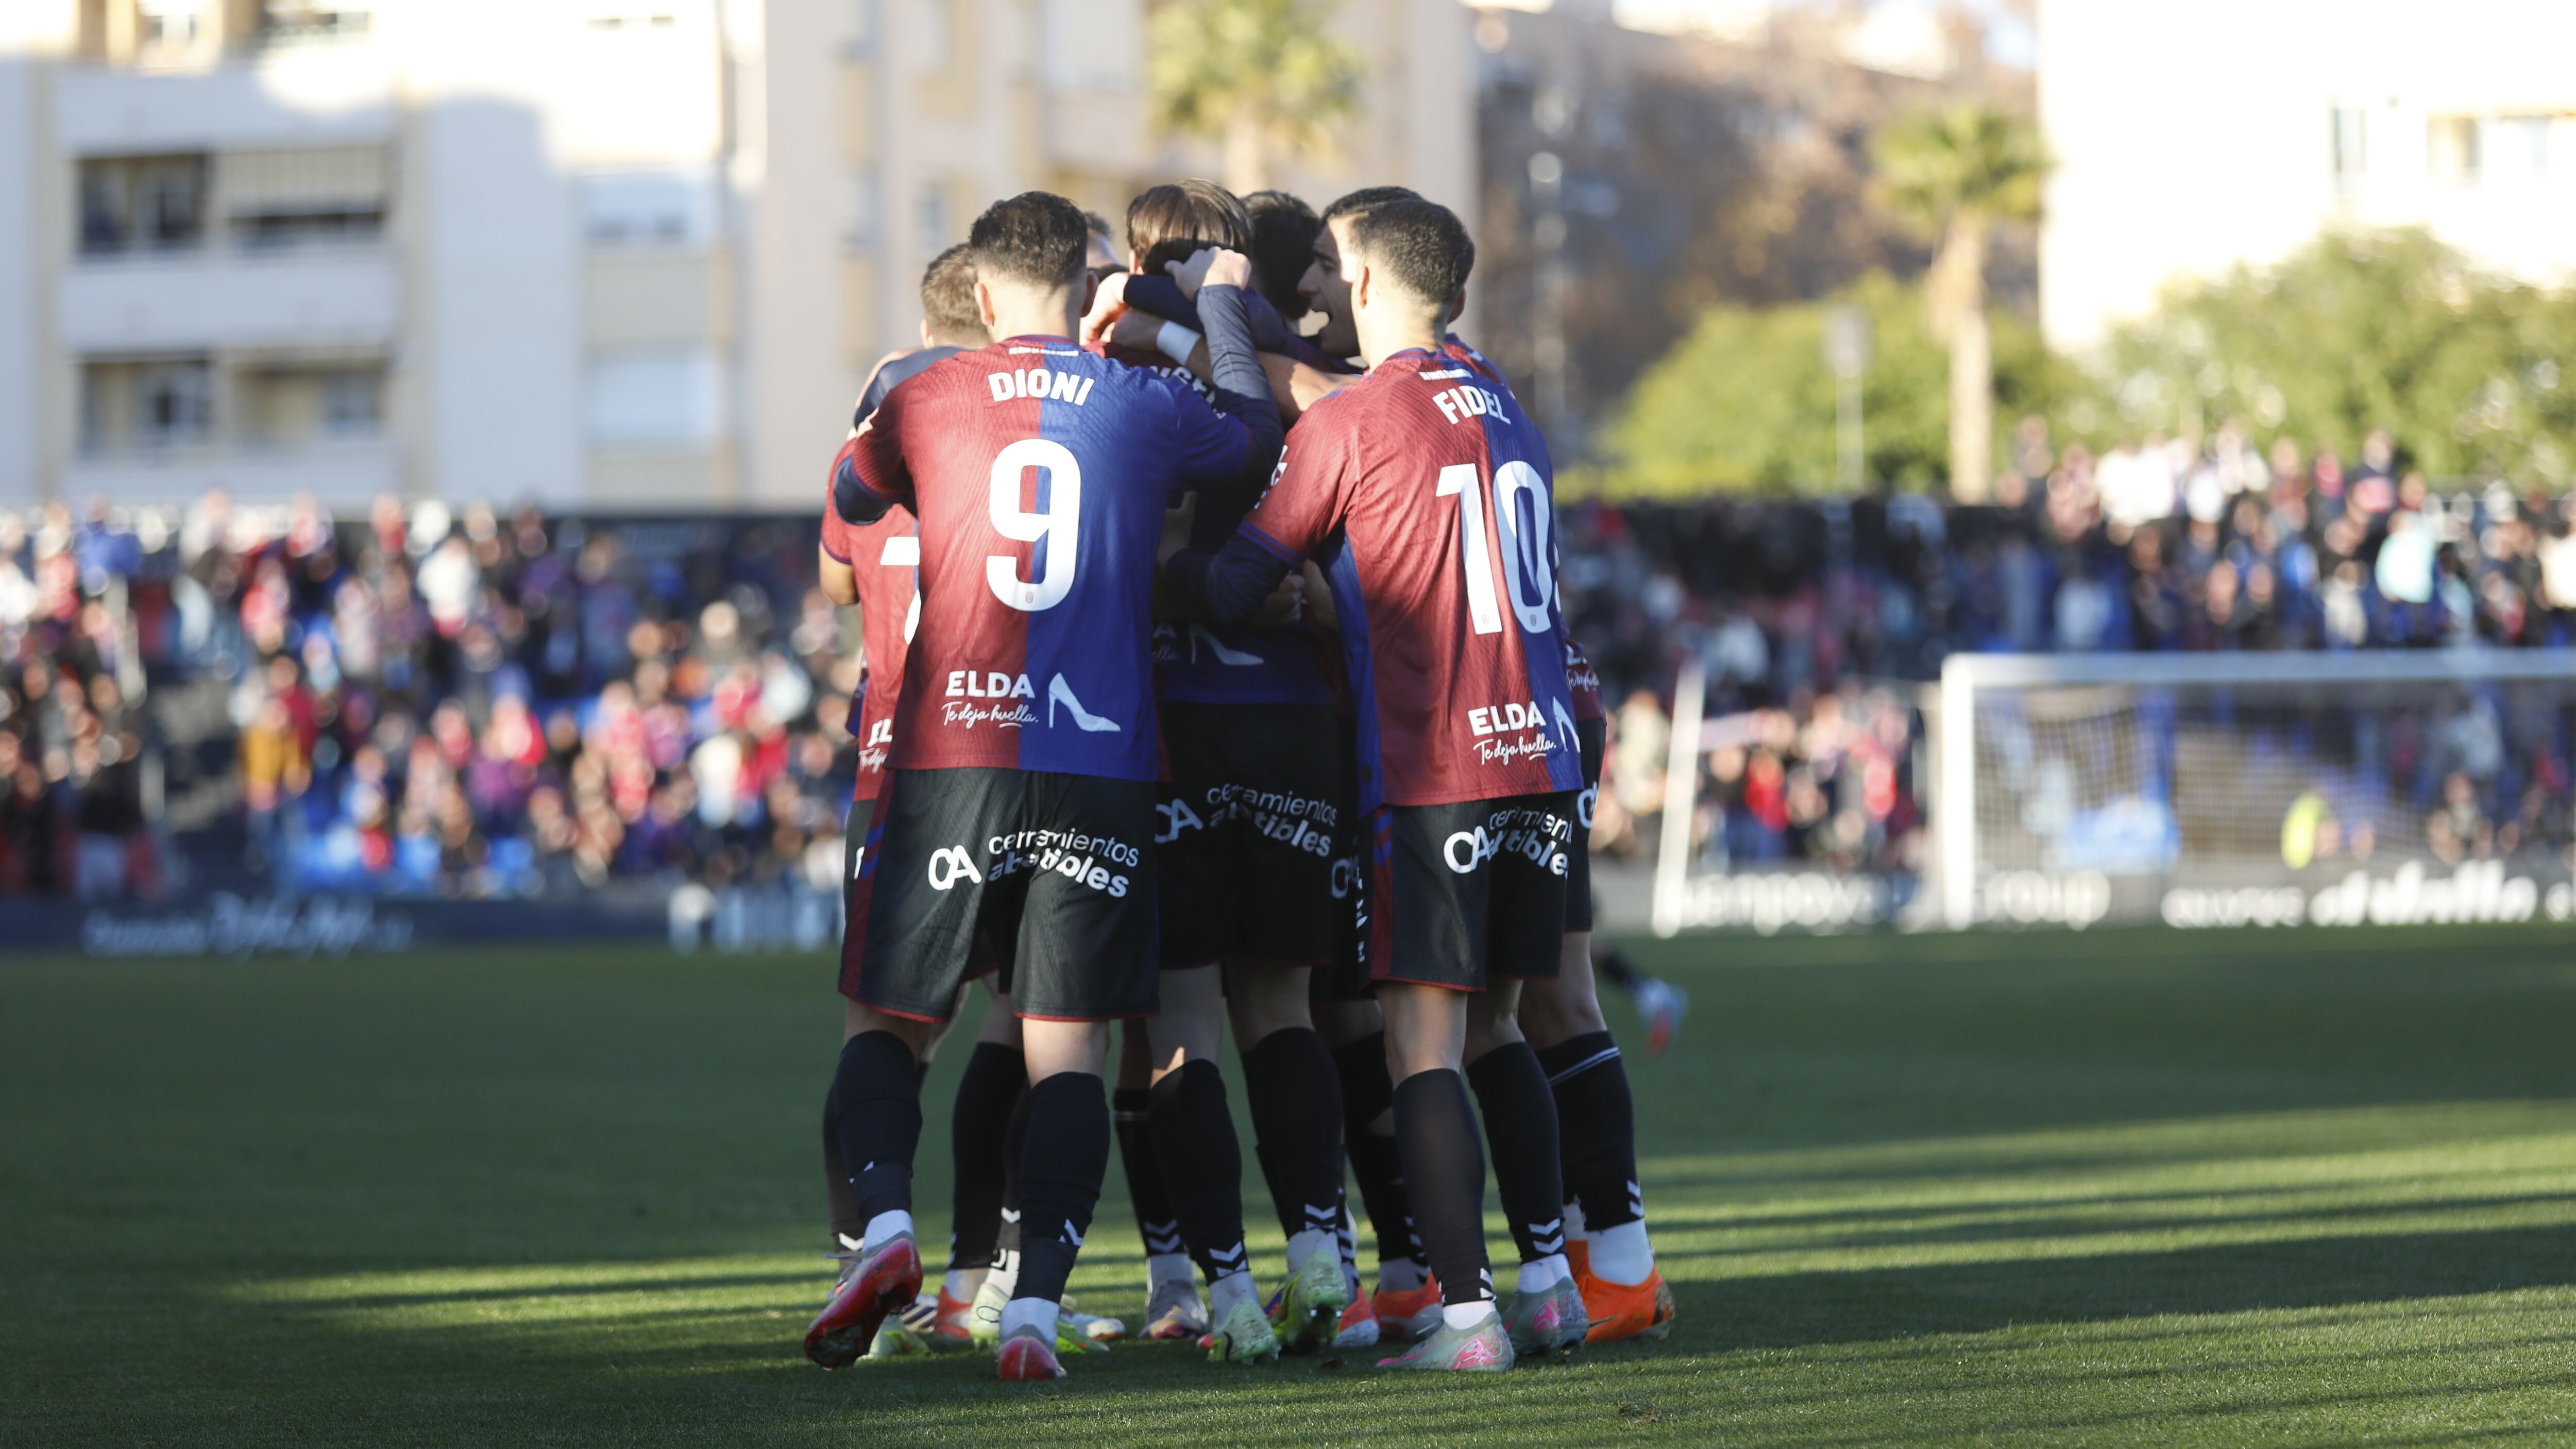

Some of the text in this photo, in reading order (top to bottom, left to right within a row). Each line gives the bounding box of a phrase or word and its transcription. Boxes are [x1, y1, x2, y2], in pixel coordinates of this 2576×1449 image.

[988, 368, 1094, 406] DIONI
[1432, 385, 1511, 425] FIDEL
[986, 439, 1081, 612] 9
[1435, 460, 1552, 635] 10
[945, 670, 1036, 699] ELDA
[941, 701, 1039, 729] Te deja huella.
[1467, 700, 1547, 736] ELDA
[1472, 738, 1494, 766] Te
[1494, 739, 1518, 766] deja
[928, 845, 982, 890] CA
[1444, 825, 1493, 874] CA
